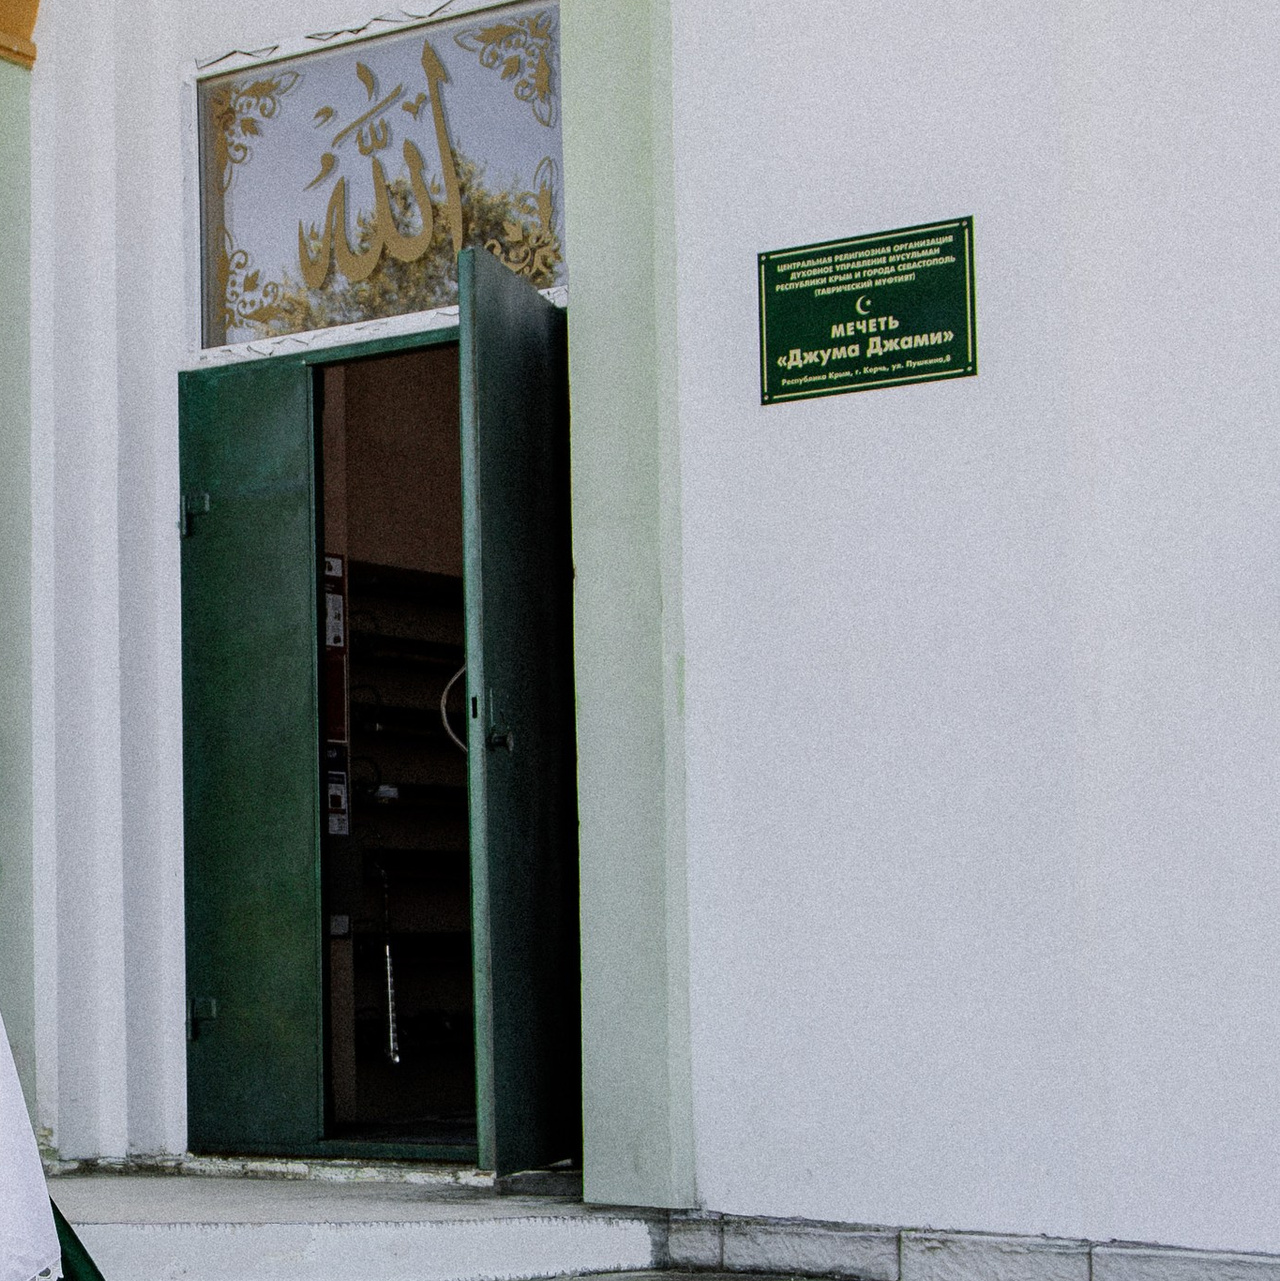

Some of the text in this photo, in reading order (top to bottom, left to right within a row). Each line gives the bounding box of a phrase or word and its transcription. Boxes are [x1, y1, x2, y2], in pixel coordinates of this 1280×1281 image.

[777, 235, 953, 272] ЦЕНТРАЛЬНАЯ РЕЛИГИОЗНАЯ ОРГАНИЗАЦИЯ
[790, 247, 940, 280] ДУХОВНОЕ УПРАВЛЕНИЕ МУСУЛЬМАН
[775, 255, 956, 292] РЕСПУБЛИКИ КРЫМ И ГОРОДА СЕВАСТОПОЛЬ
[814, 272, 915, 297] (ТАВРИЧЕСКИЙ МУФТИЯТ)
[831, 315, 899, 339] МЕЧЕТЬ
[777, 330, 954, 370] «Джума Джами»
